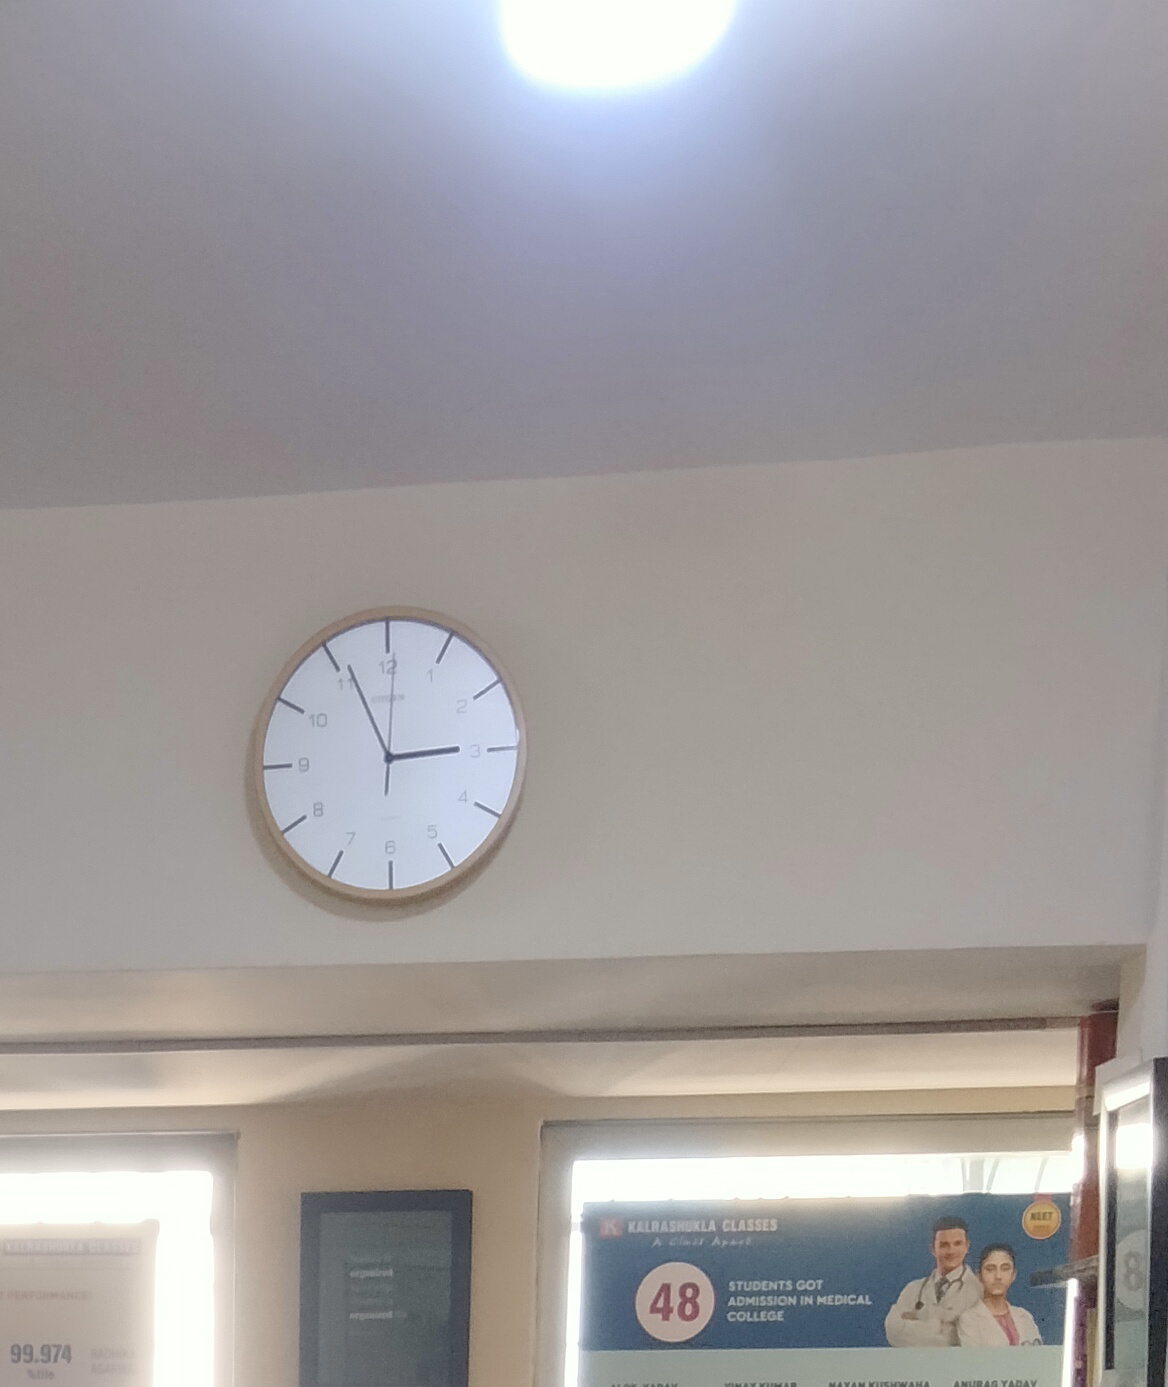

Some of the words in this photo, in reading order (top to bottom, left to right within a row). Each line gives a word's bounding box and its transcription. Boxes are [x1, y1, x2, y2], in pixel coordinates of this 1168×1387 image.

[379, 659, 397, 675] 12
[426, 668, 434, 682] 1
[337, 677, 354, 691] 11
[456, 700, 468, 714] 2
[309, 712, 328, 728] 10
[470, 744, 481, 758] 3
[298, 757, 310, 772] 9
[457, 790, 469, 804] 4
[312, 802, 324, 818] 8
[345, 831, 357, 846] 7
[427, 824, 438, 839] 5
[384, 840, 397, 855] 6
[628, 1219, 717, 1233] KALRASHUKLA
[722, 1218, 779, 1232] CLASSES
[651, 1237, 663, 1248] A
[728, 1280, 793, 1292] STUDENTS
[796, 1279, 824, 1291] GOT
[648, 1281, 701, 1322] 48
[727, 1295, 797, 1307] ADMISSION
[799, 1295, 814, 1306] IN
[816, 1294, 873, 1306] MEDICAL
[726, 1310, 785, 1322] COLLEGE
[10, 1343, 72, 1364] 99.974
